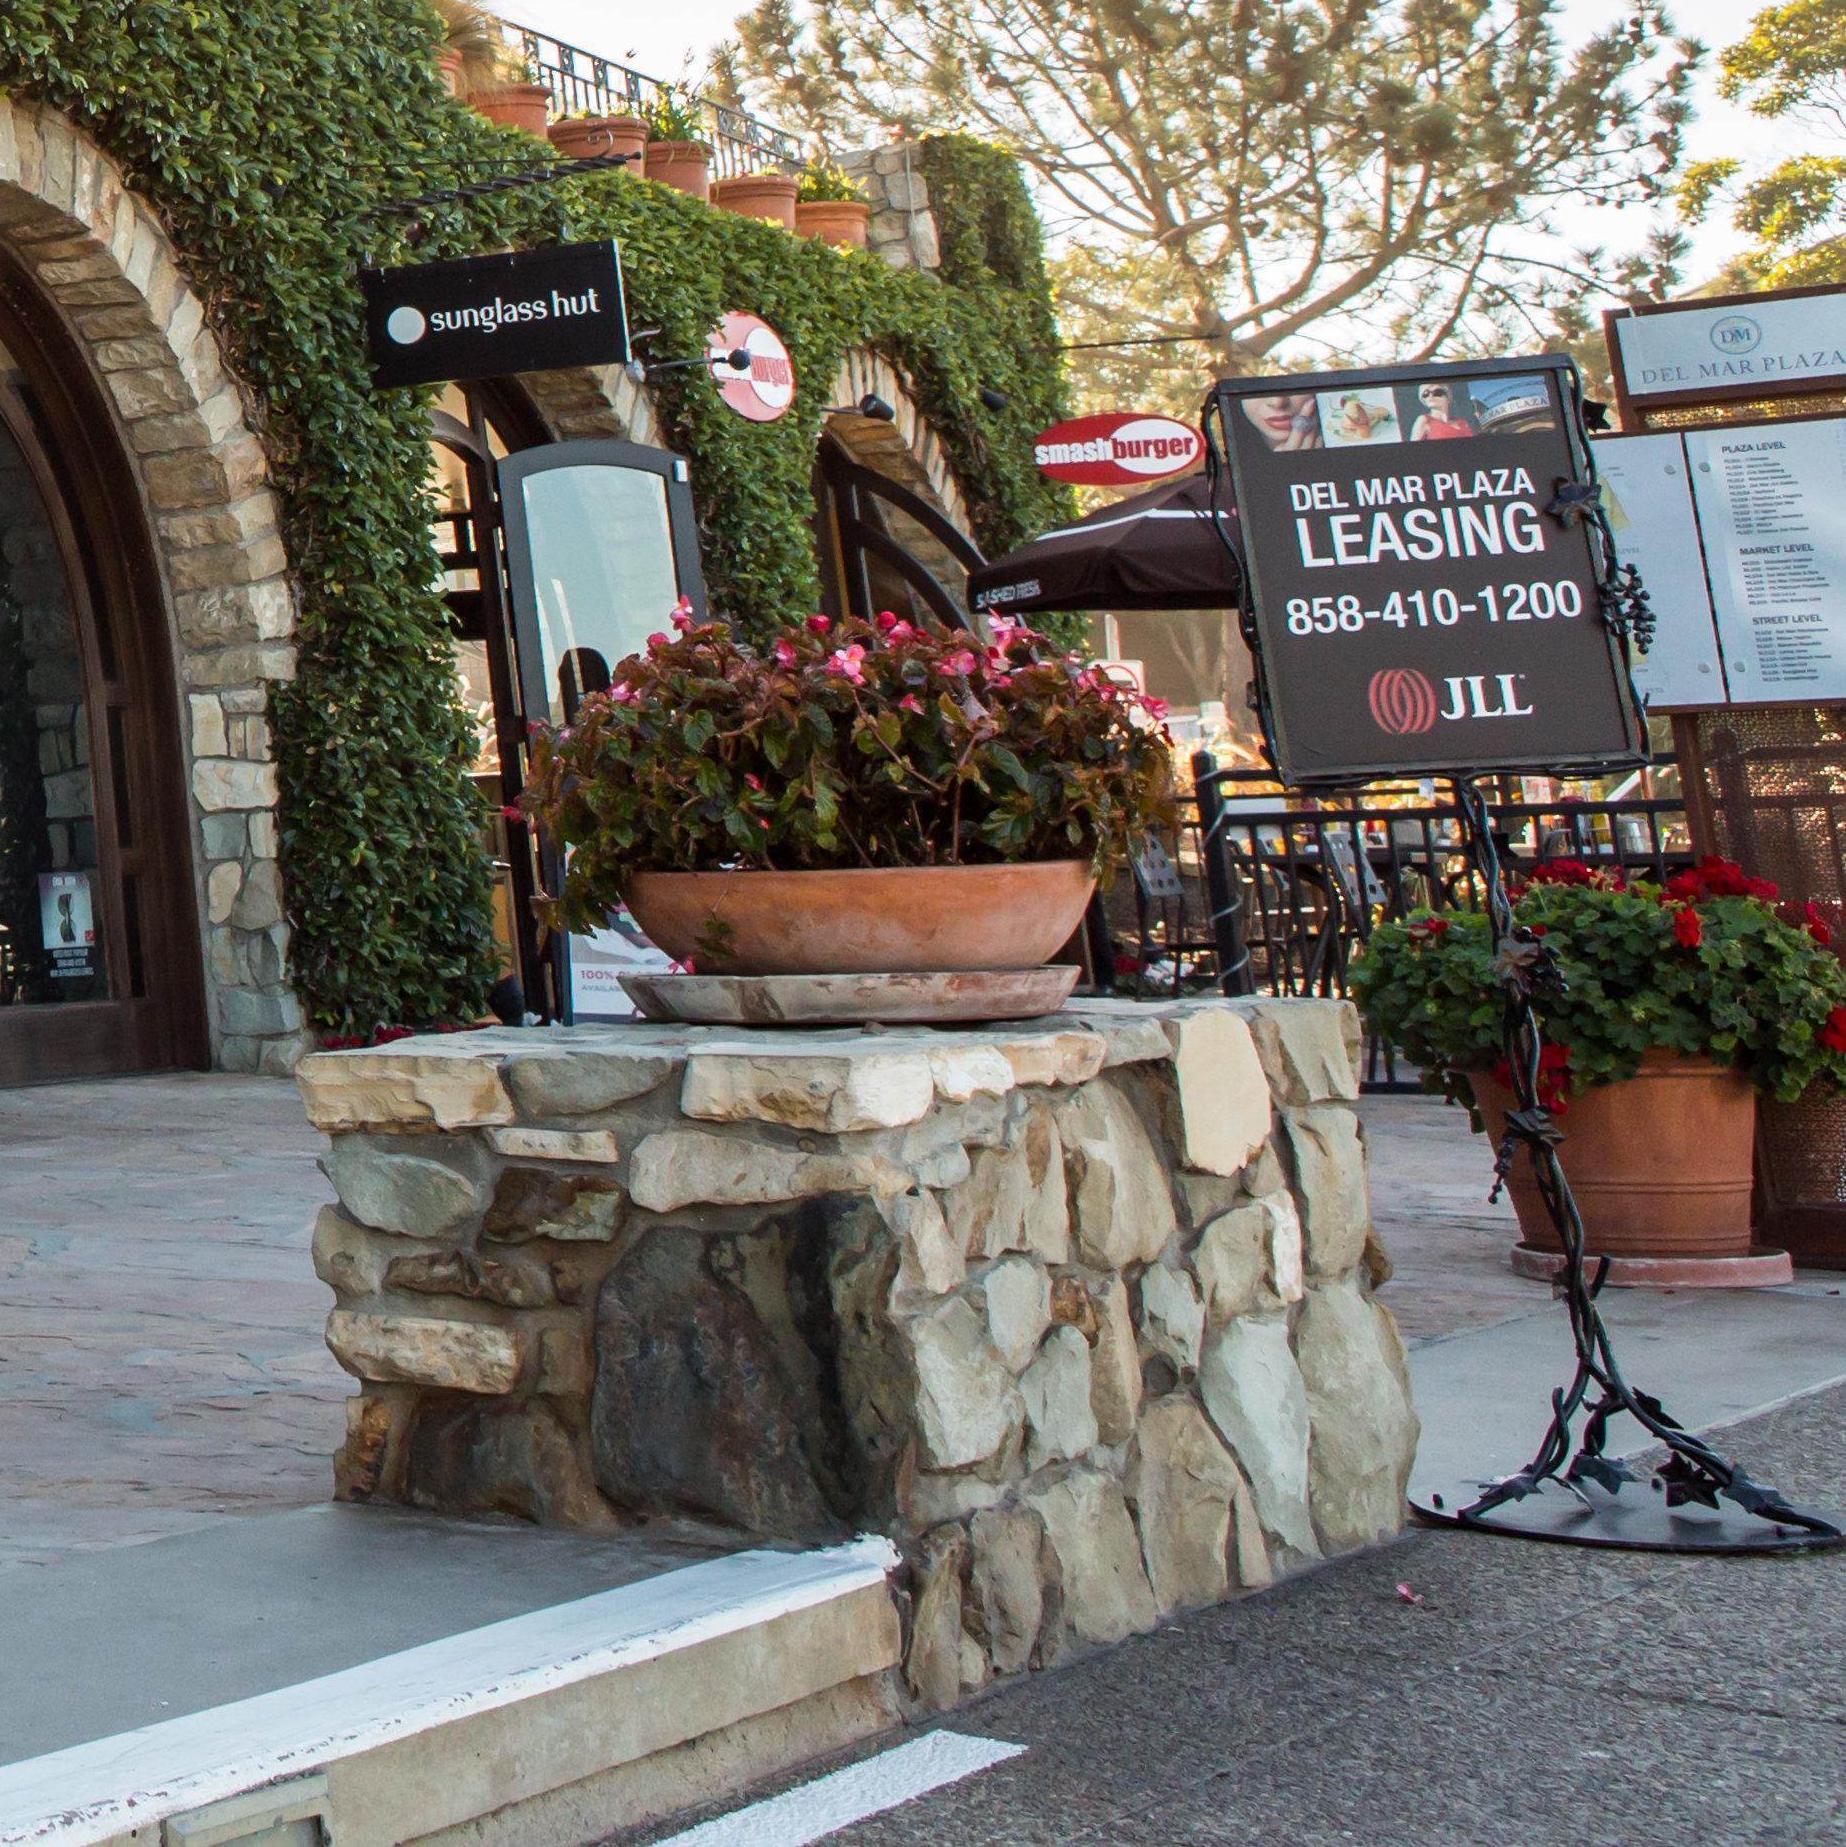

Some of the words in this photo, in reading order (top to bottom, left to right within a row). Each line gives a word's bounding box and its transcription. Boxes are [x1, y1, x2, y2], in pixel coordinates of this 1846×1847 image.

[430, 297, 548, 333] sunglass
[551, 288, 601, 318] hut
[1720, 328, 1752, 344] DM
[1641, 366, 1690, 385] DEL
[1699, 359, 1755, 379] MAR
[1762, 350, 1846, 372] PLAZA
[1034, 434, 1194, 466] smashburger
[1722, 444, 1754, 454] PLAZA
[1756, 441, 1786, 452] LEVEL
[1290, 482, 1350, 512] DEL
[1354, 475, 1427, 507] MAR
[1433, 467, 1536, 501] PLAZA
[1295, 501, 1546, 568] LEASING
[1739, 545, 1780, 555] MARKET
[1784, 543, 1815, 553] LEVEL
[1285, 580, 1582, 635] 858-410-1200
[1752, 615, 1789, 626] STREET
[1792, 614, 1824, 624] LEVEL
[1440, 673, 1534, 721] JLL
[581, 970, 615, 980] 100%
